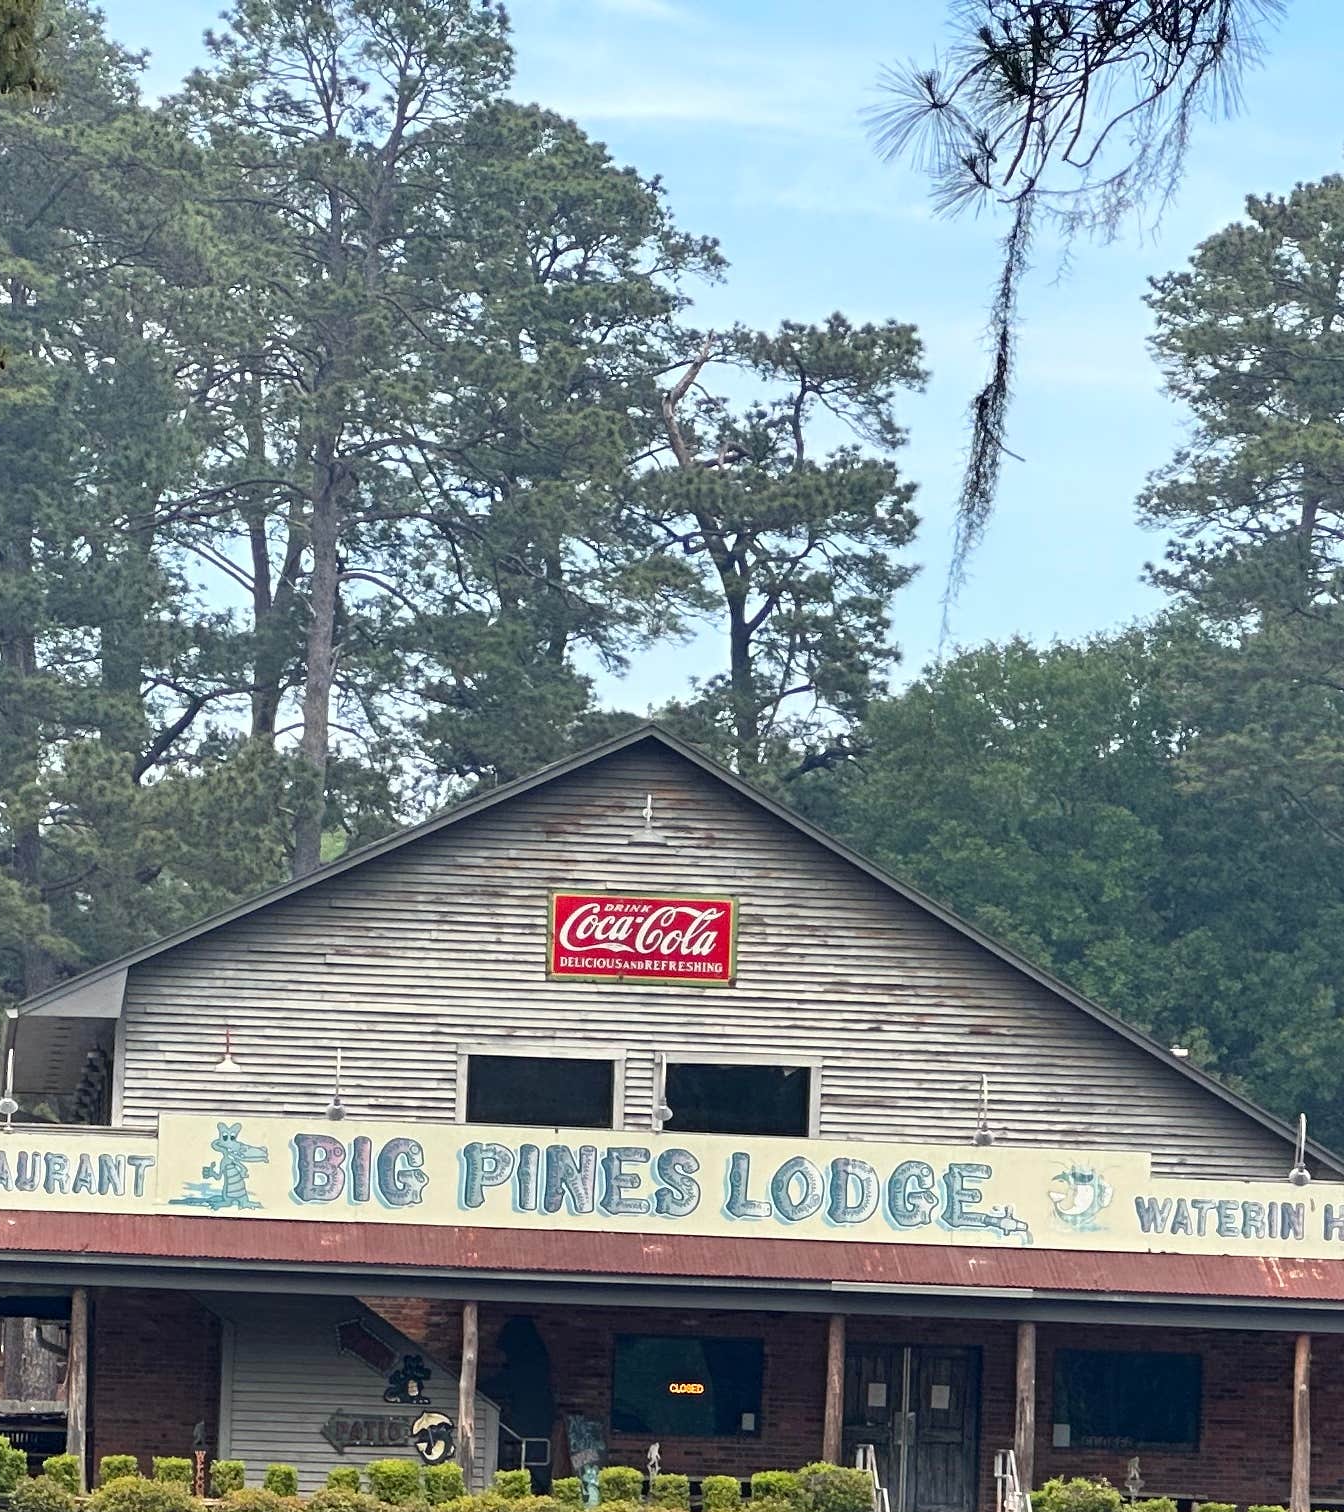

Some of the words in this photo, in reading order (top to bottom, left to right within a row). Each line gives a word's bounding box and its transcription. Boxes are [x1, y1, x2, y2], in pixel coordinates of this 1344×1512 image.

[604, 904, 653, 913] DRINK
[559, 903, 725, 956] Coca-Cola
[560, 956, 622, 968] DELICIOUS
[623, 961, 645, 970] AND
[646, 960, 723, 973] REFRESHING
[290, 1134, 430, 1206] BIG
[459, 1142, 701, 1219] PINES
[724, 1151, 993, 1228] LODGE
[1135, 1196, 1315, 1239] WATERIN'
[669, 1383, 705, 1394] CLOSED
[336, 1421, 402, 1441] PATIO
